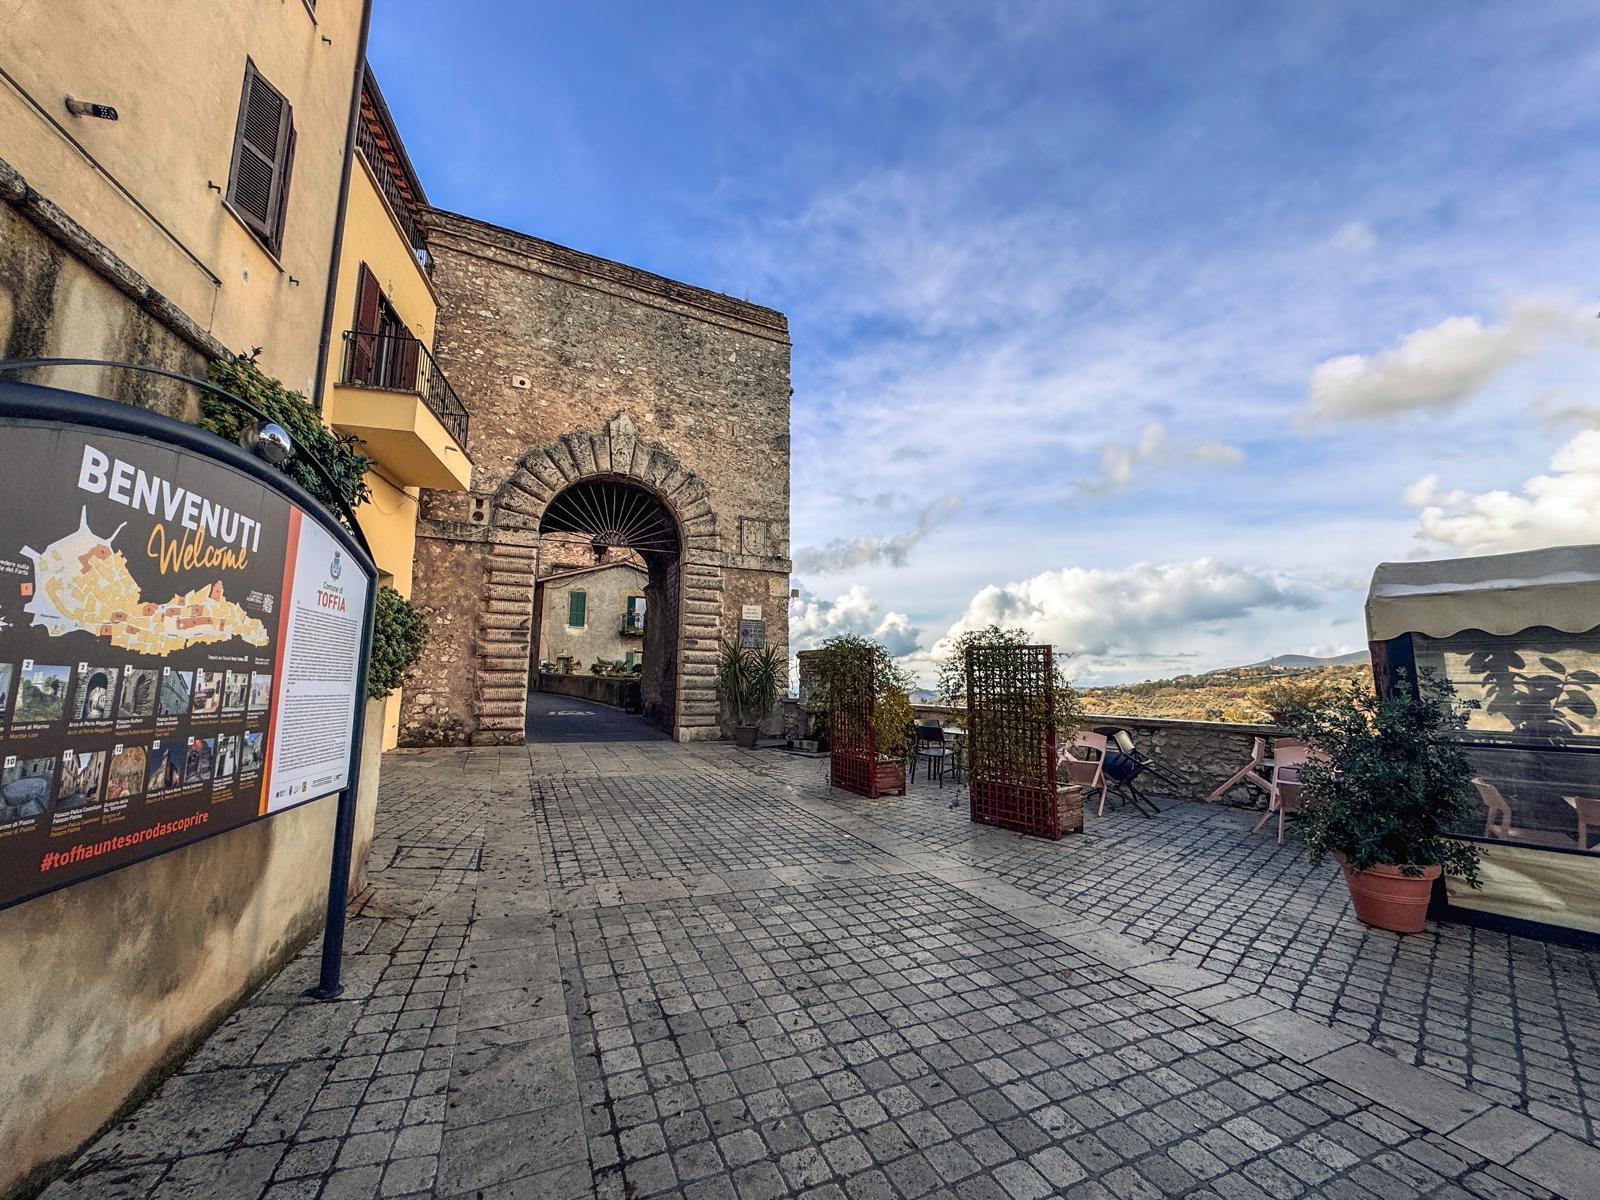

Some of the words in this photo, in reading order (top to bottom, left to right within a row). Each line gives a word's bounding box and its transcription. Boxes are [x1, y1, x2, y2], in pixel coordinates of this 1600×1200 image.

[78, 444, 261, 553] BENVENUTI
[147, 523, 248, 575] Welcome
[317, 589, 346, 612] TOFFIA
[323, 581, 338, 593] Comune
[40, 811, 209, 872] #toffiauntesorodascoprire
